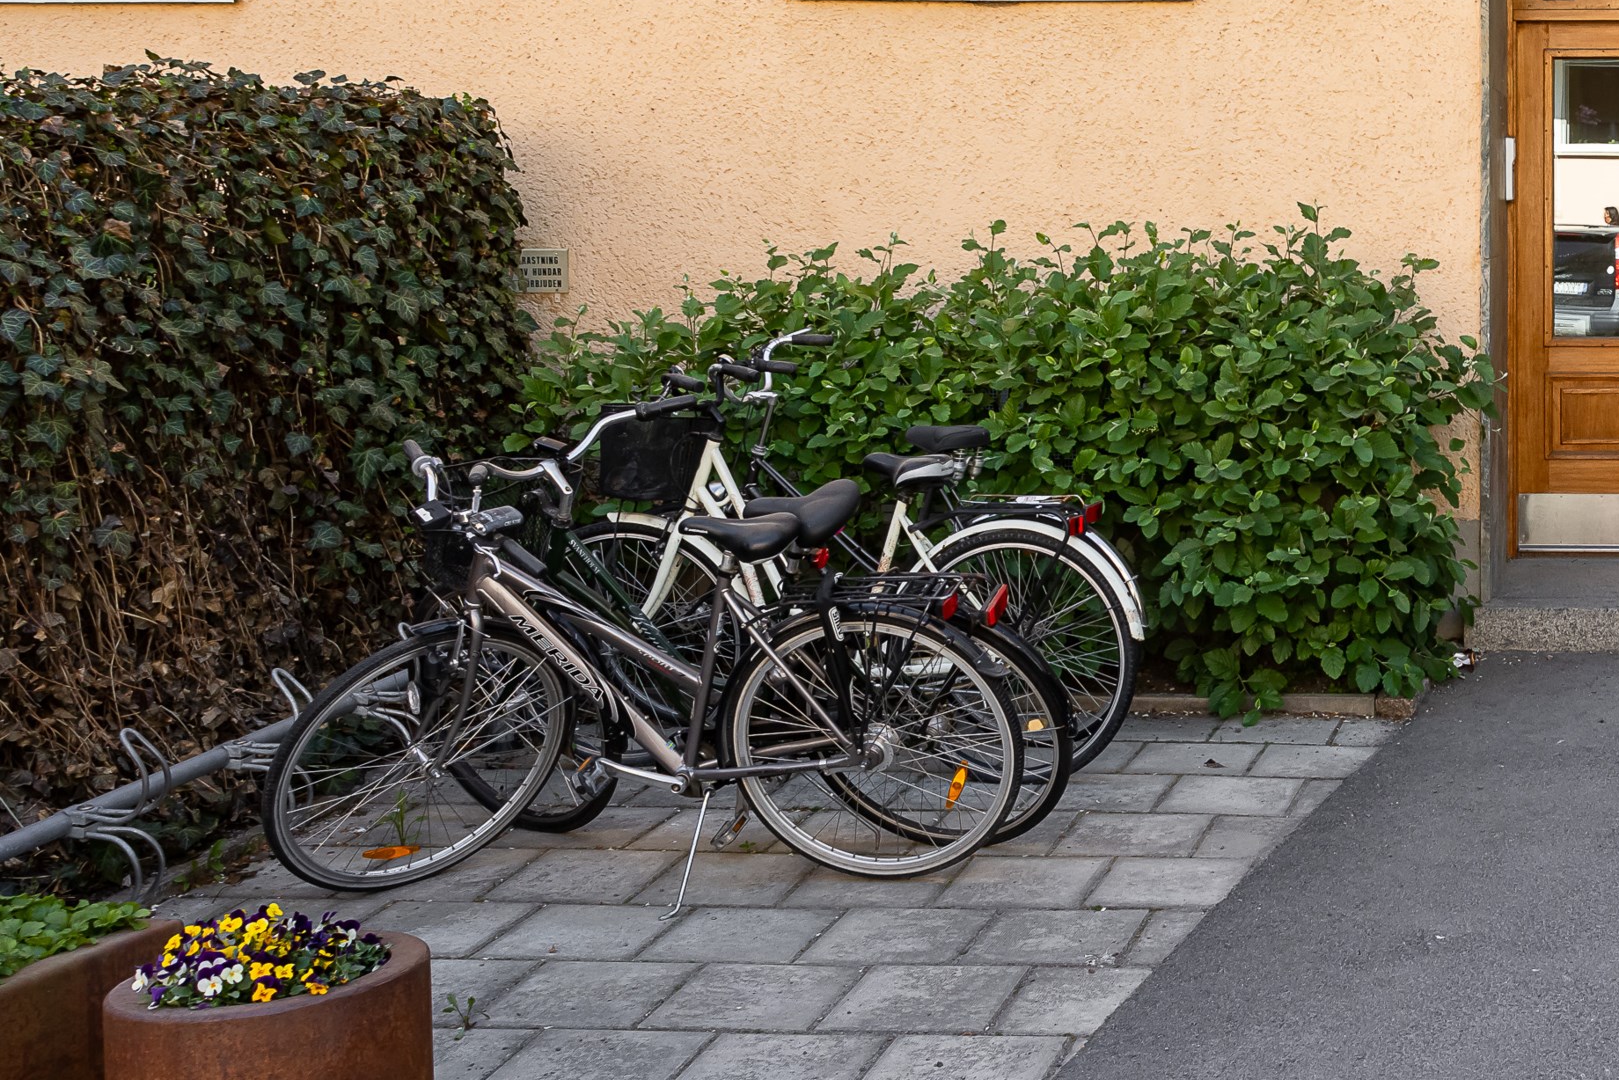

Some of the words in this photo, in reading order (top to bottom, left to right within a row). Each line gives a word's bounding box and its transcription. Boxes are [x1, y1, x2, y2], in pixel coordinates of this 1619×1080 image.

[521, 256, 559, 265] RASTNING
[532, 268, 562, 276] HUNDAR
[508, 614, 604, 701] MERIDA
